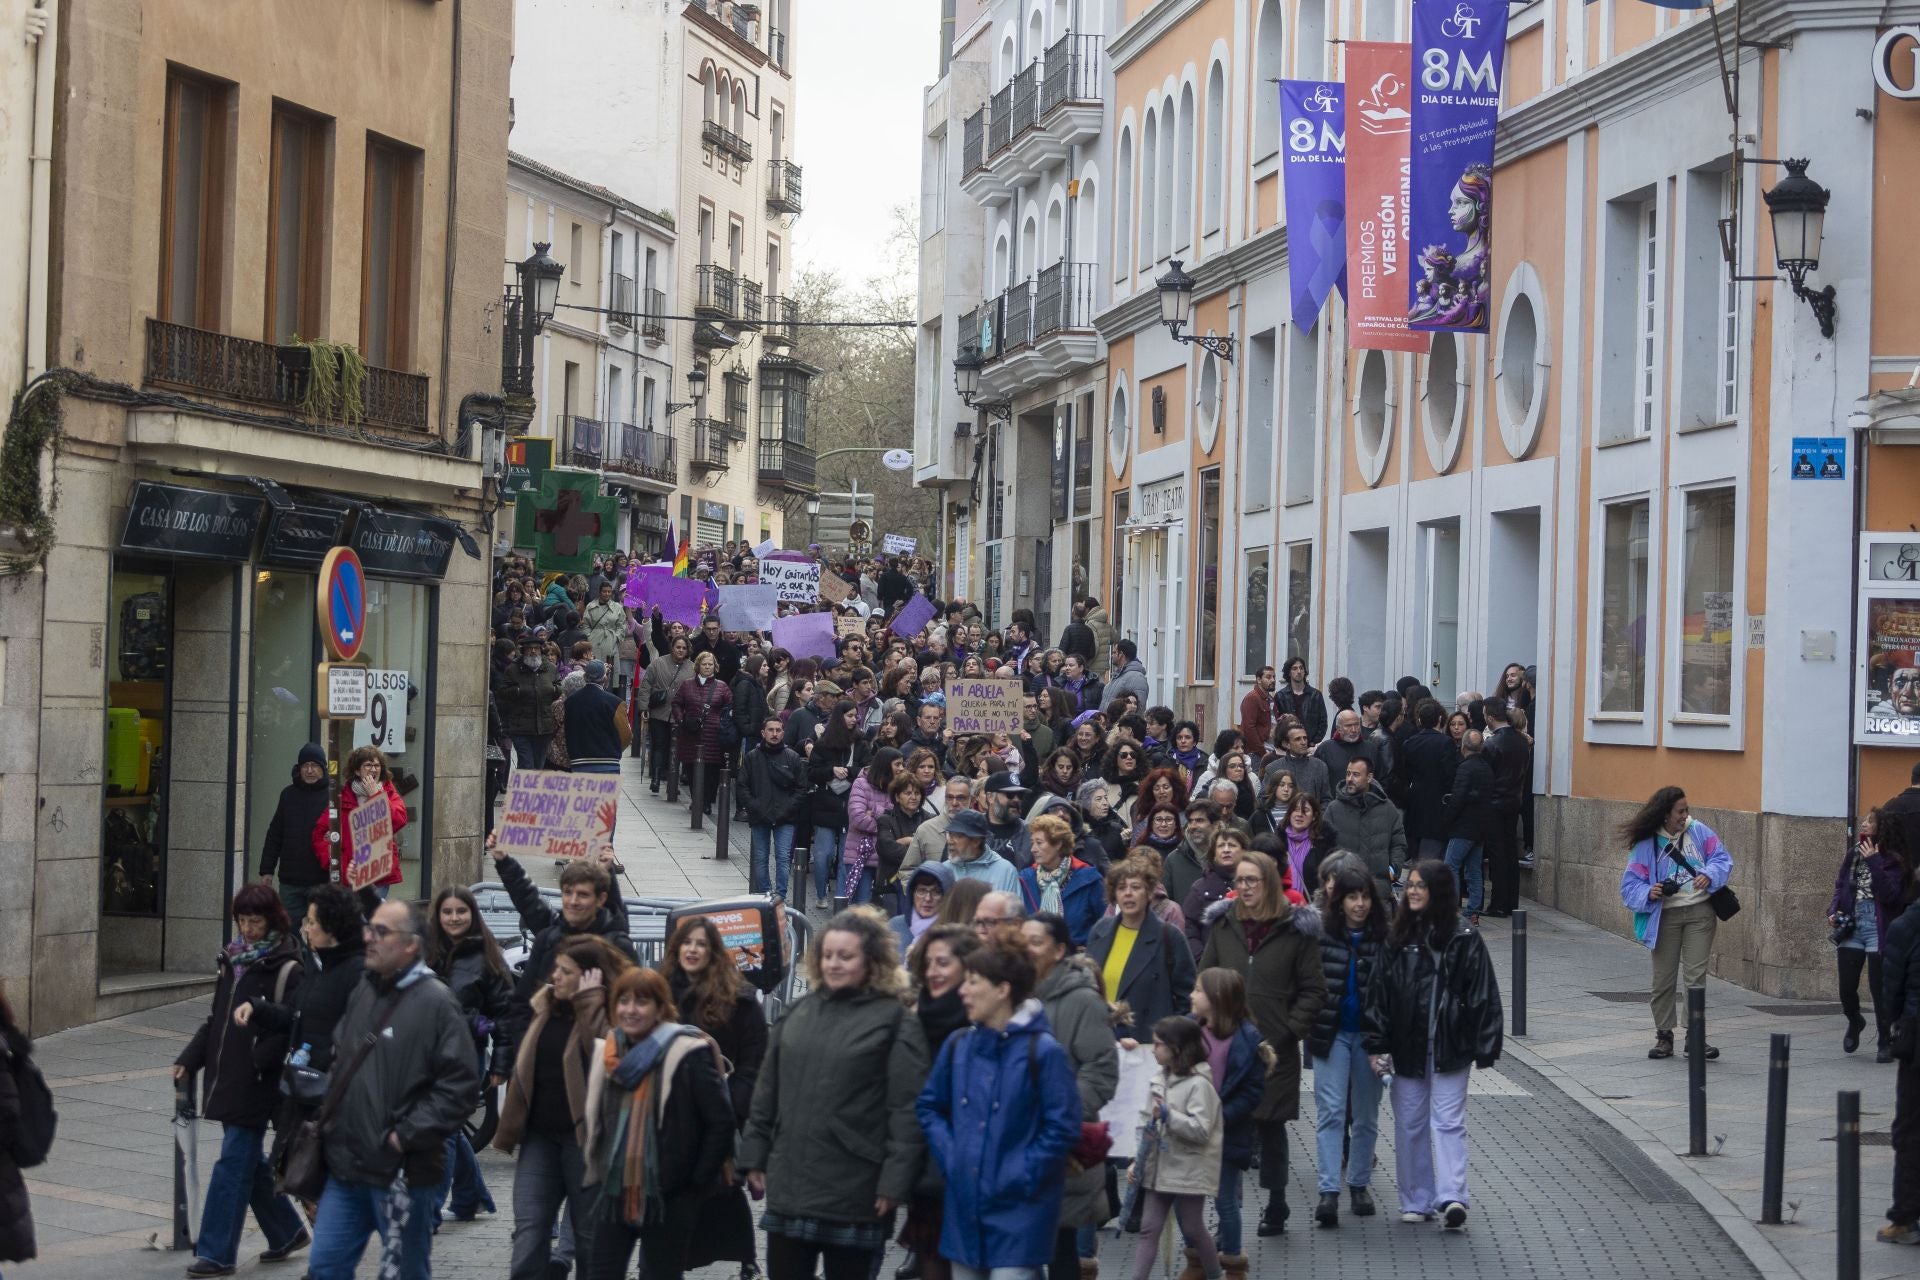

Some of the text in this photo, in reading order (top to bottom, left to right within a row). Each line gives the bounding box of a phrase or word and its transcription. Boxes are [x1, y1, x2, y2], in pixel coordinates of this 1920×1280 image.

[1421, 48, 1497, 93] 8M
[1421, 95, 1439, 104] DIA
[1441, 96, 1453, 105] DE
[1455, 97, 1468, 105] LA
[1289, 117, 1345, 153] 8M
[1429, 128, 1458, 140] Teatro
[1460, 118, 1489, 133] Aplaude
[1430, 143, 1442, 152] las
[1443, 128, 1496, 148] Protagonistas
[1290, 155, 1304, 163] DIA
[1308, 155, 1320, 163] DE
[1377, 195, 1397, 276] VERSIÓN
[1361, 220, 1377, 299] PREMIOS
[1163, 485, 1184, 512] TEATR
[140, 506, 250, 537] CASA DE LOS BOLSOS
[360, 530, 383, 550] CASA
[383, 533, 400, 552] DE
[397, 535, 417, 553] LOS
[763, 561, 783, 579] HOY
[789, 581, 805, 591] QUE
[367, 672, 406, 690] OLSOS
[968, 683, 1005, 699] ABUELA
[370, 693, 388, 748] 9
[953, 716, 980, 731] PARA
[973, 709, 987, 718] QUE
[585, 779, 597, 792] TU
[353, 799, 388, 831] QUIERO
[572, 795, 600, 815] QUE
[585, 815, 598, 830] TE
